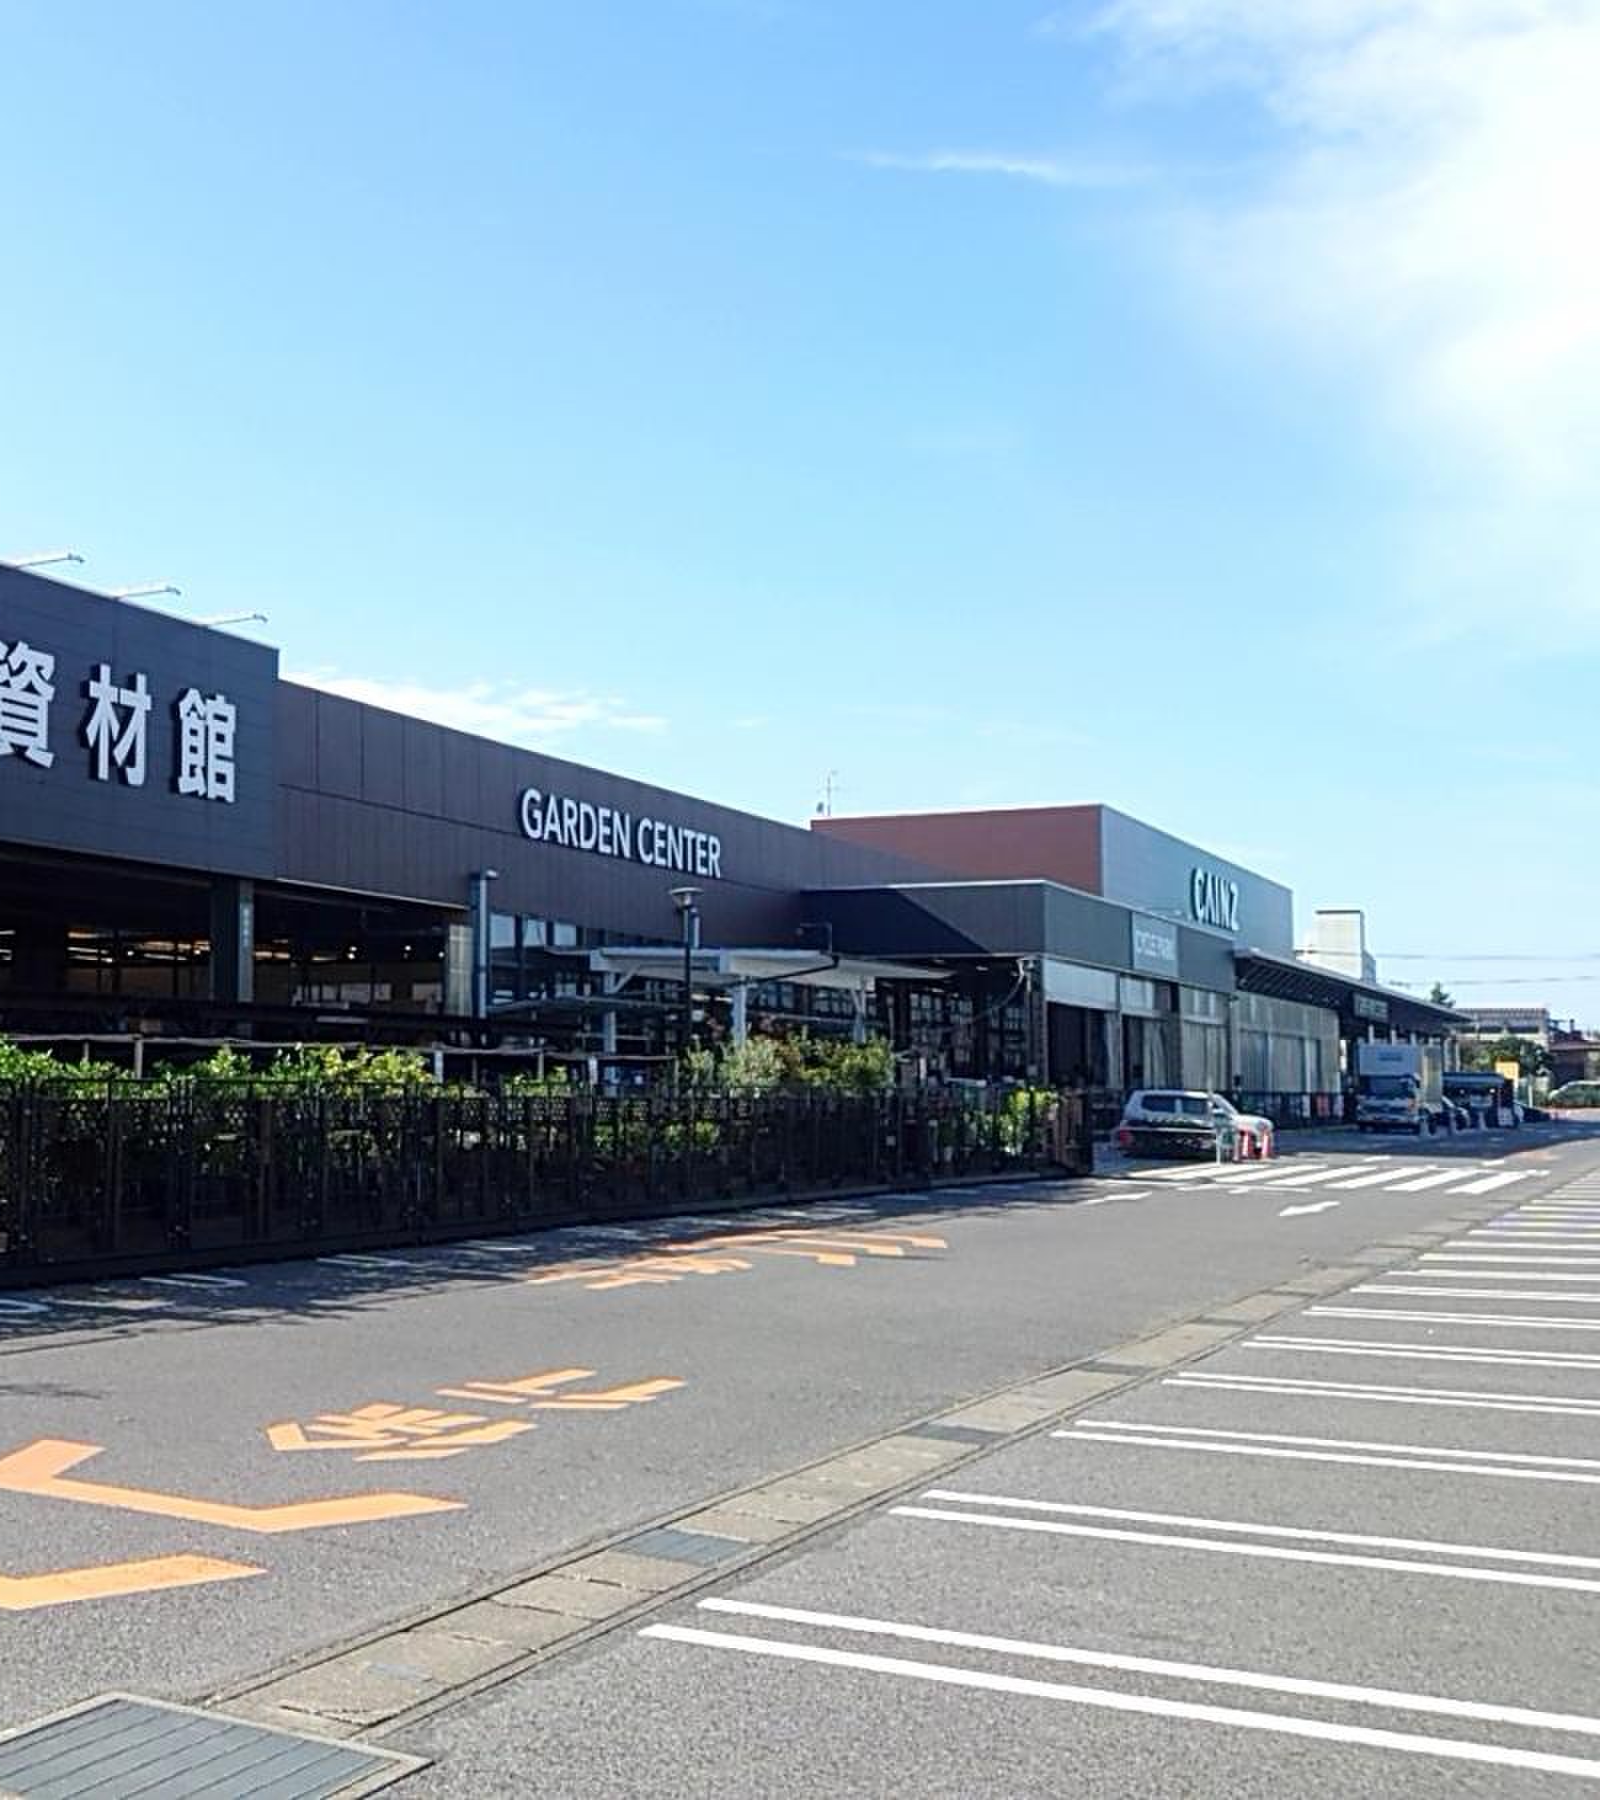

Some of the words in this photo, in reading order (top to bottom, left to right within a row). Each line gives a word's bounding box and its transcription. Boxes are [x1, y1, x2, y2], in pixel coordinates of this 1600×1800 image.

[521, 789, 631, 858] GARDEN
[637, 817, 722, 879] CENTER
[1194, 868, 1239, 931] CAINZ
